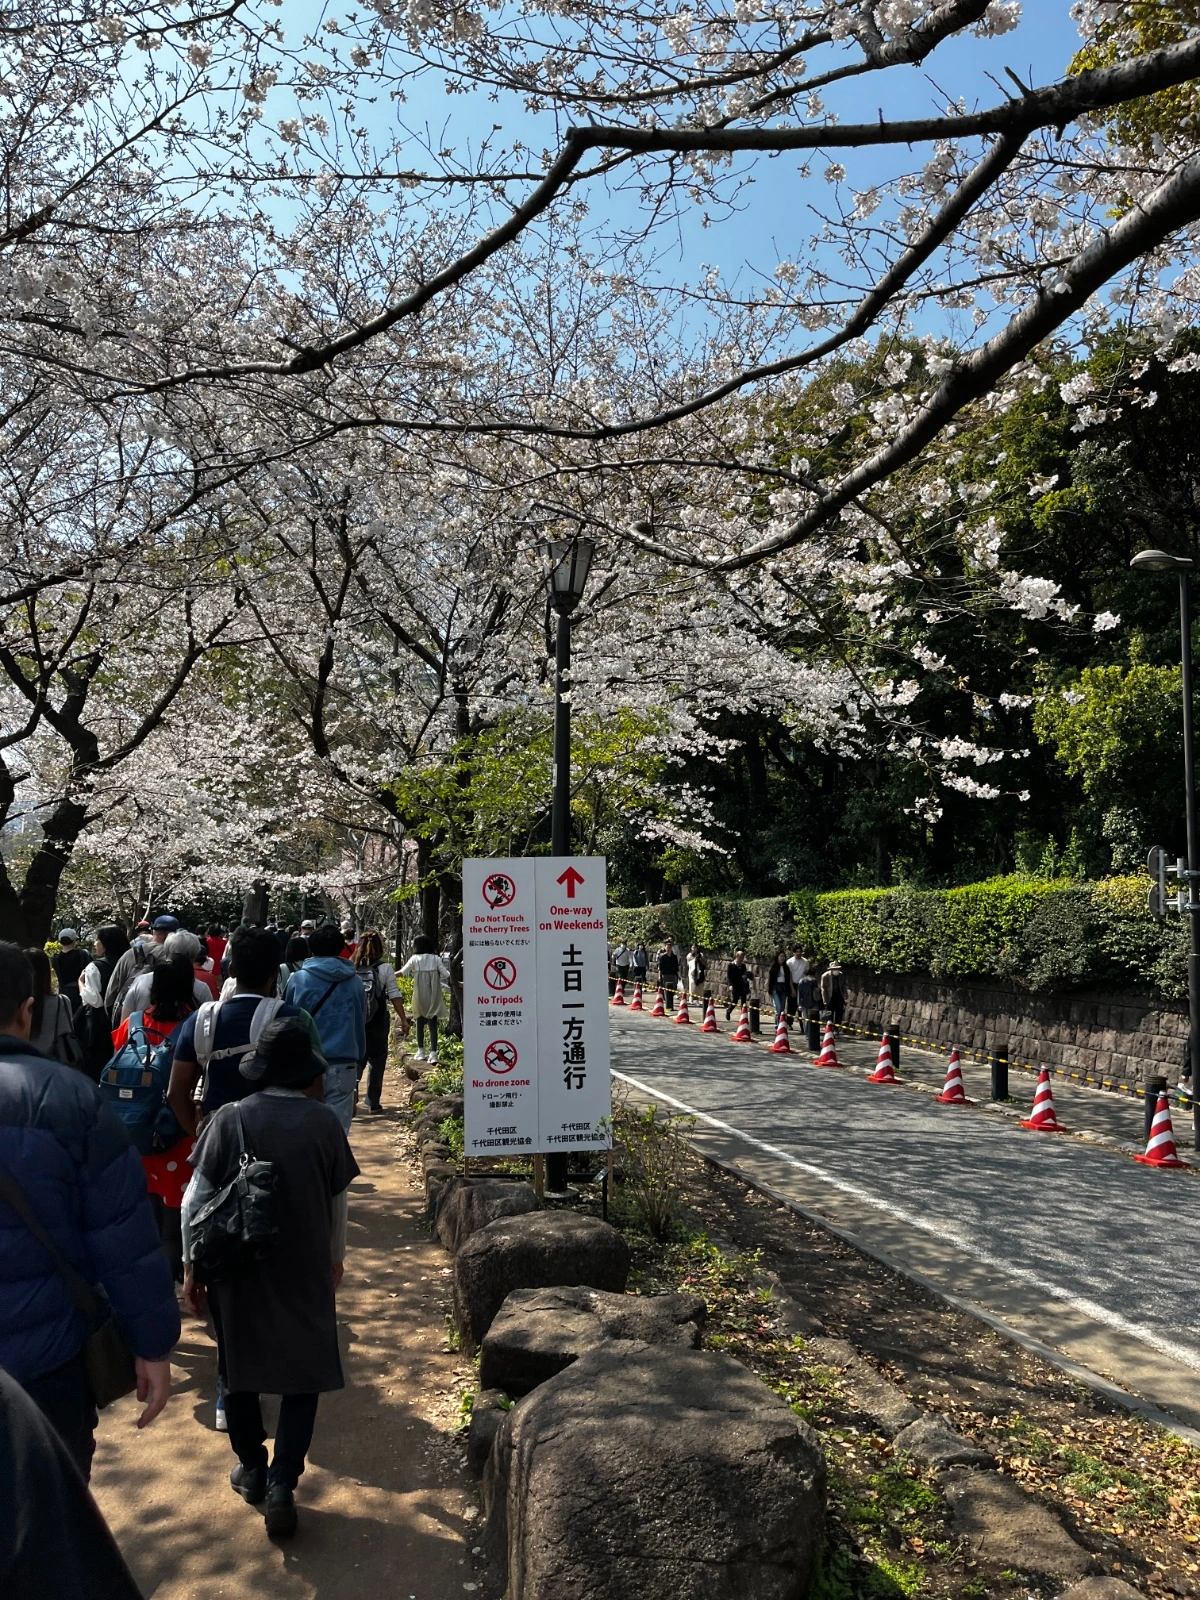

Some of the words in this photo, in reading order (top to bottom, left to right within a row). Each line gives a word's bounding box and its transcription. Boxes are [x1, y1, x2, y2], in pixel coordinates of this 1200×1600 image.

[550, 905, 592, 917] One-way
[539, 922, 551, 930] on
[554, 920, 603, 929] Weekends
[484, 926, 508, 934] Cherry
[491, 995, 523, 1005] Tripods
[561, 944, 586, 1091] 土日一方通行
[485, 1079, 509, 1087] drone
[486, 1126, 517, 1135] 千代田区
[561, 1123, 591, 1131] 千代田区
[472, 1138, 532, 1147] 千代田区観光協会
[547, 1133, 605, 1143] 千代田区観光協会
